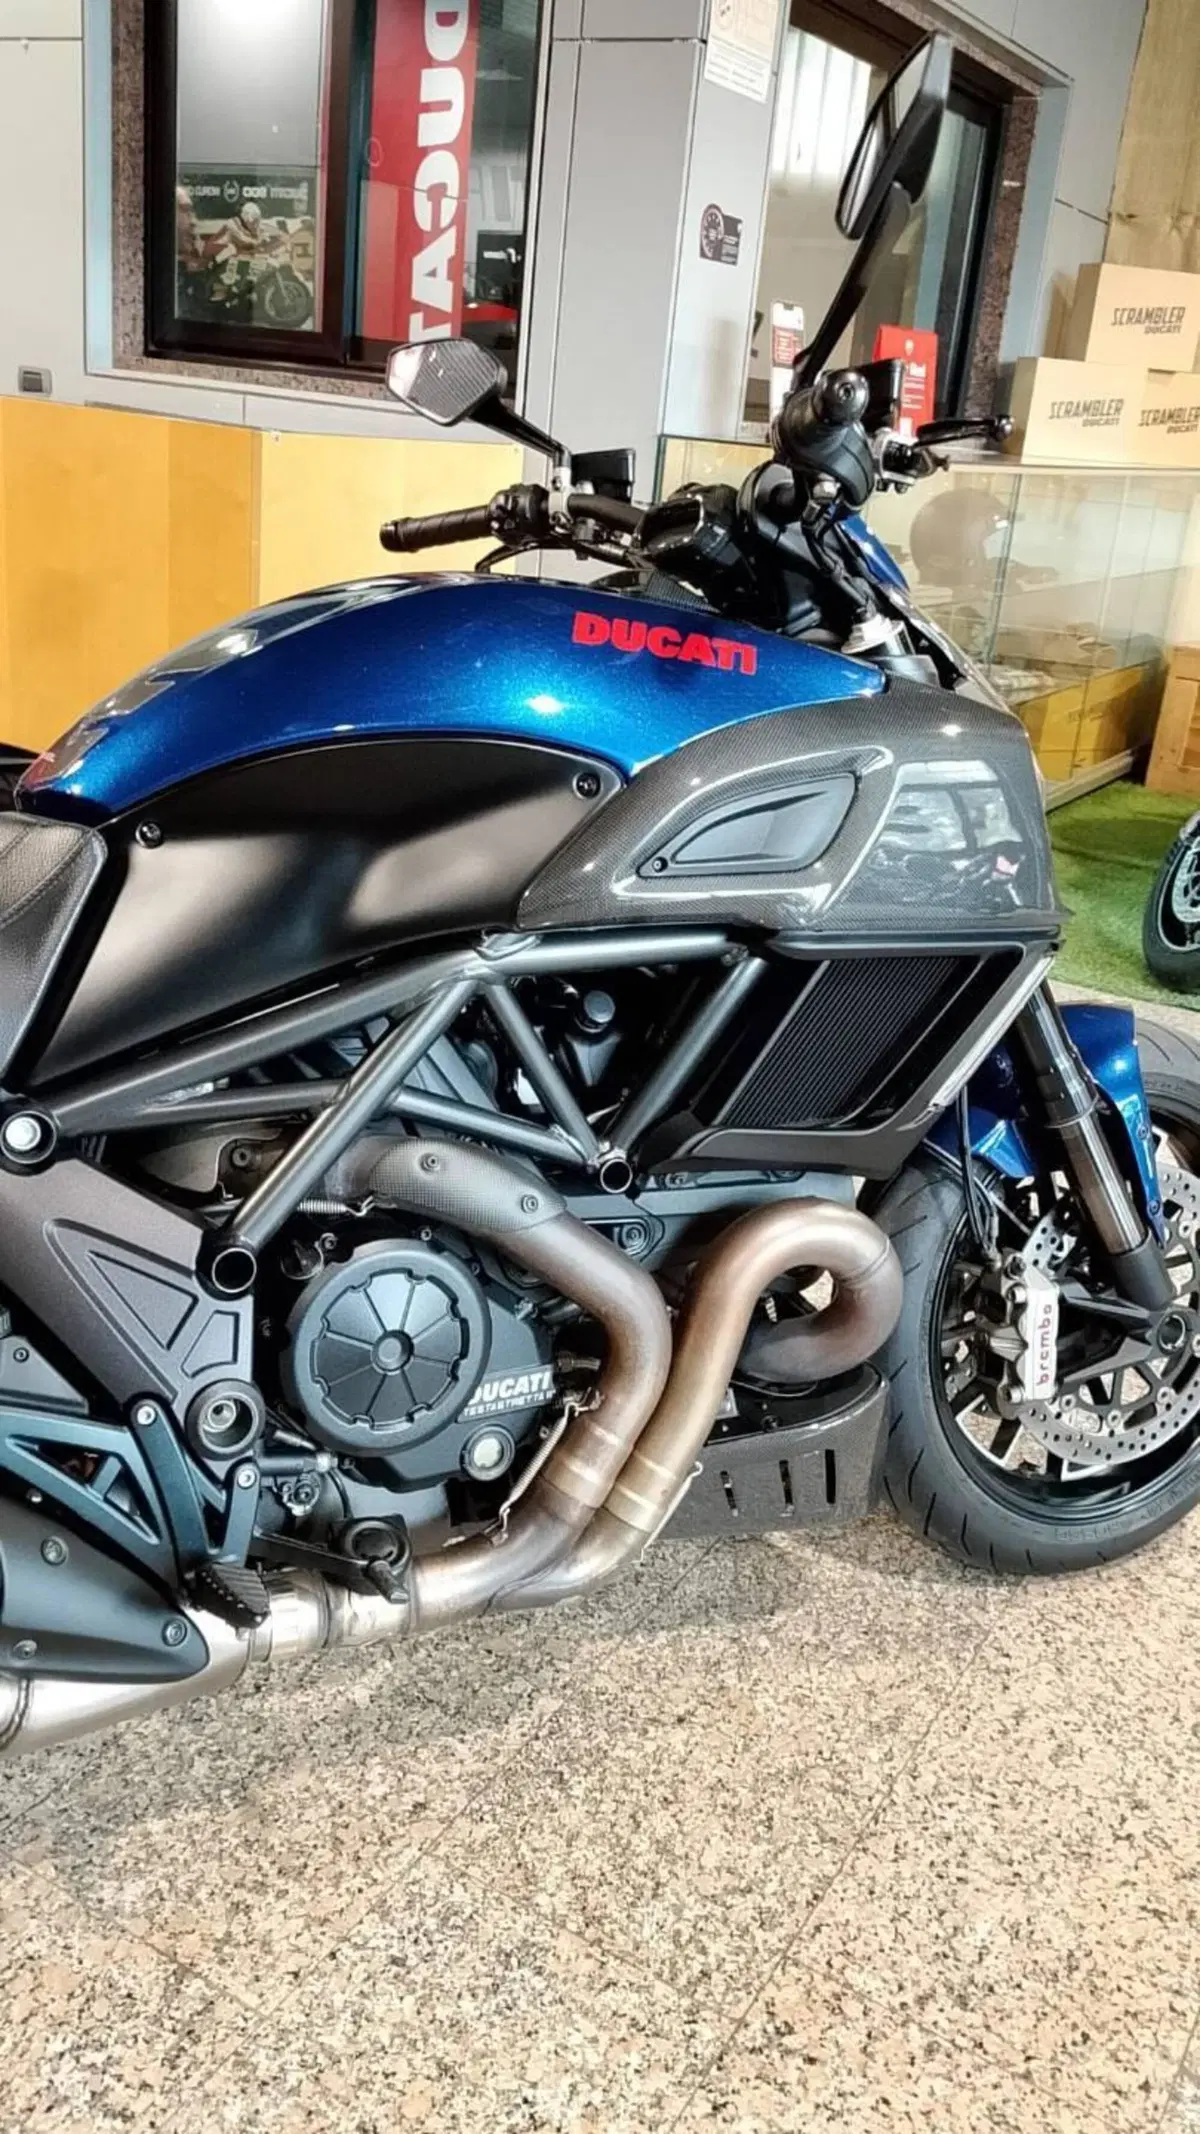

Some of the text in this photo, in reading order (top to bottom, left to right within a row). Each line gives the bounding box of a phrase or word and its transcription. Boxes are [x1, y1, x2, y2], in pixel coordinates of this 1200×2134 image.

[1111, 306, 1186, 326] SCRAMBLER
[1144, 324, 1182, 334] DUCATI
[1049, 398, 1124, 419] SCRAMBLER
[1082, 417, 1120, 427] DUCATI
[1166, 424, 1199, 434] DUCATI
[572, 611, 758, 676] DUCATI
[1036, 1303, 1053, 1386] brembo
